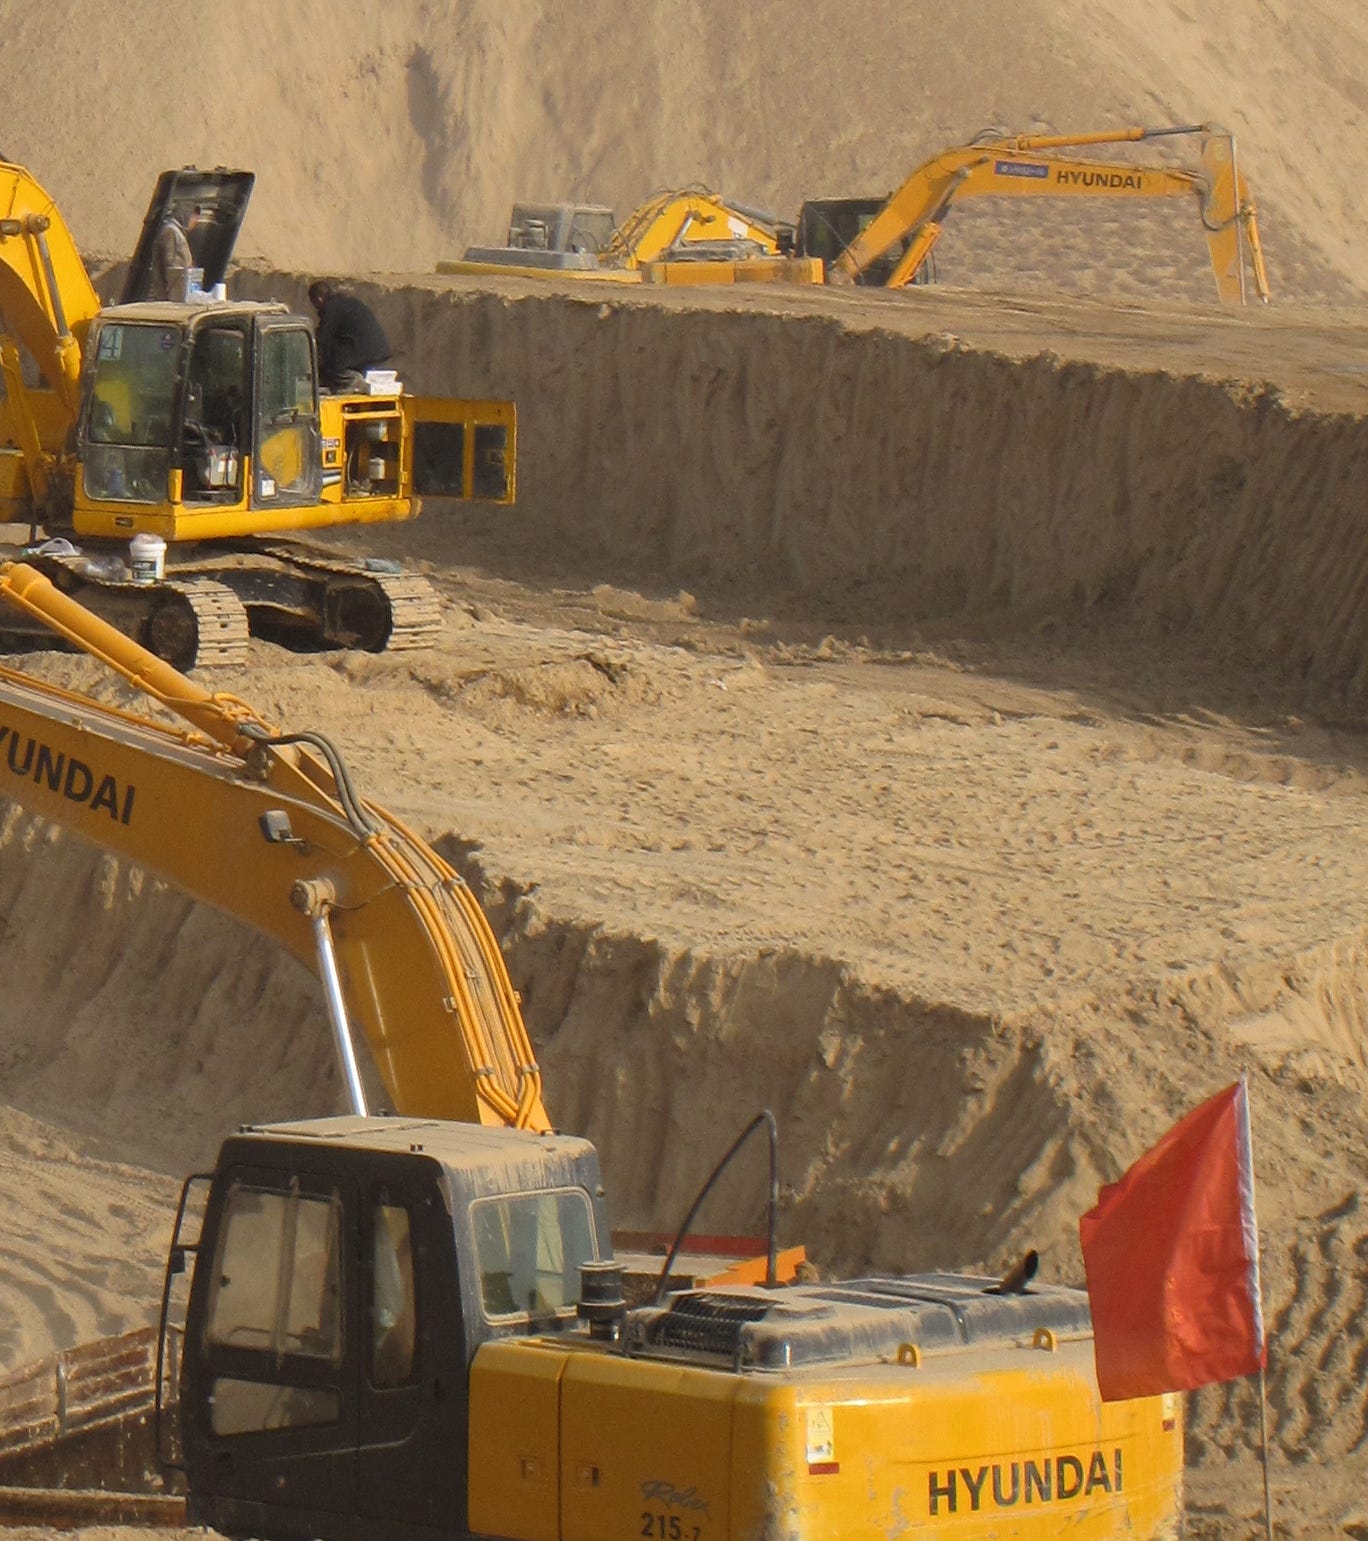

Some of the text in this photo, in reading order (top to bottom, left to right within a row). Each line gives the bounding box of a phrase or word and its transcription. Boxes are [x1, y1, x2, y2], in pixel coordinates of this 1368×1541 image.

[1056, 169, 1142, 190] HYUNDAI
[102, 326, 119, 358] 4
[928, 1448, 1123, 1517] HYUNDAI
